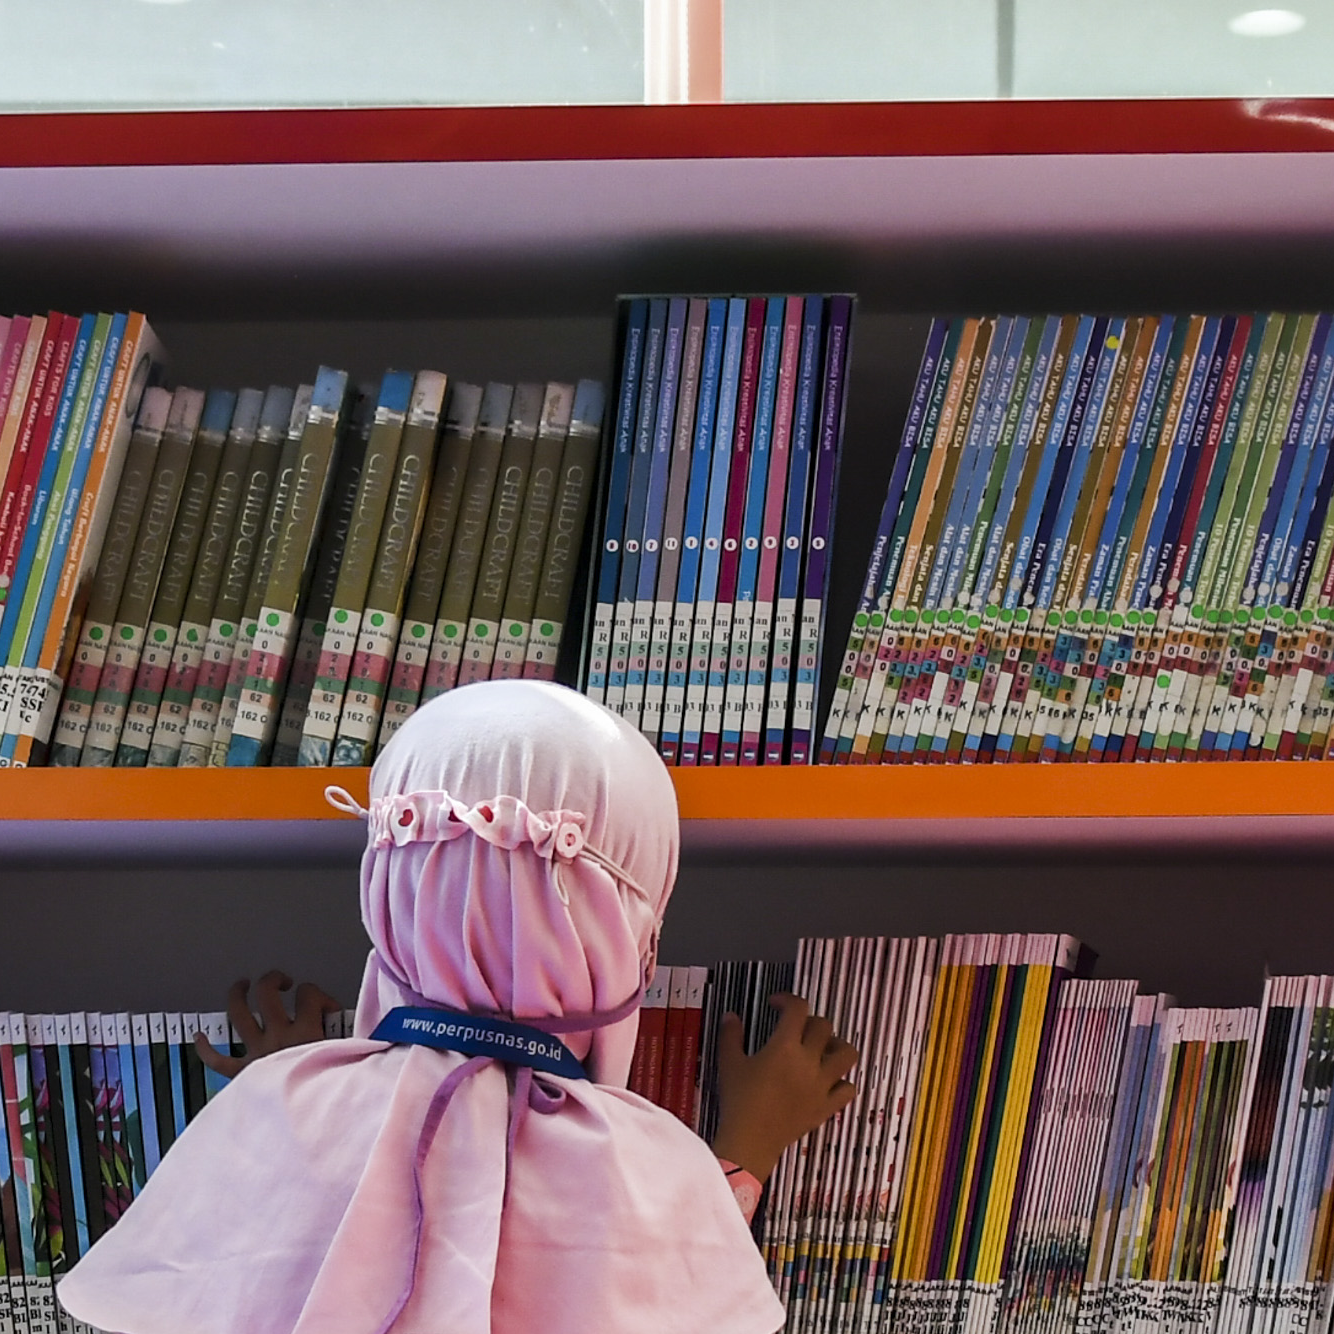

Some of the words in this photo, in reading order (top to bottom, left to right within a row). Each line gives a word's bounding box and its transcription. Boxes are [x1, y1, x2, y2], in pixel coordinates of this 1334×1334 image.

[224, 470, 269, 602] CHILDCRAFT
[376, 454, 421, 594] CHILDCRAFT
[483, 465, 523, 603] CHILDCRAFT
[250, 693, 263, 703] 62
[402, 1017, 563, 1062] www.perpusnas.go.id
